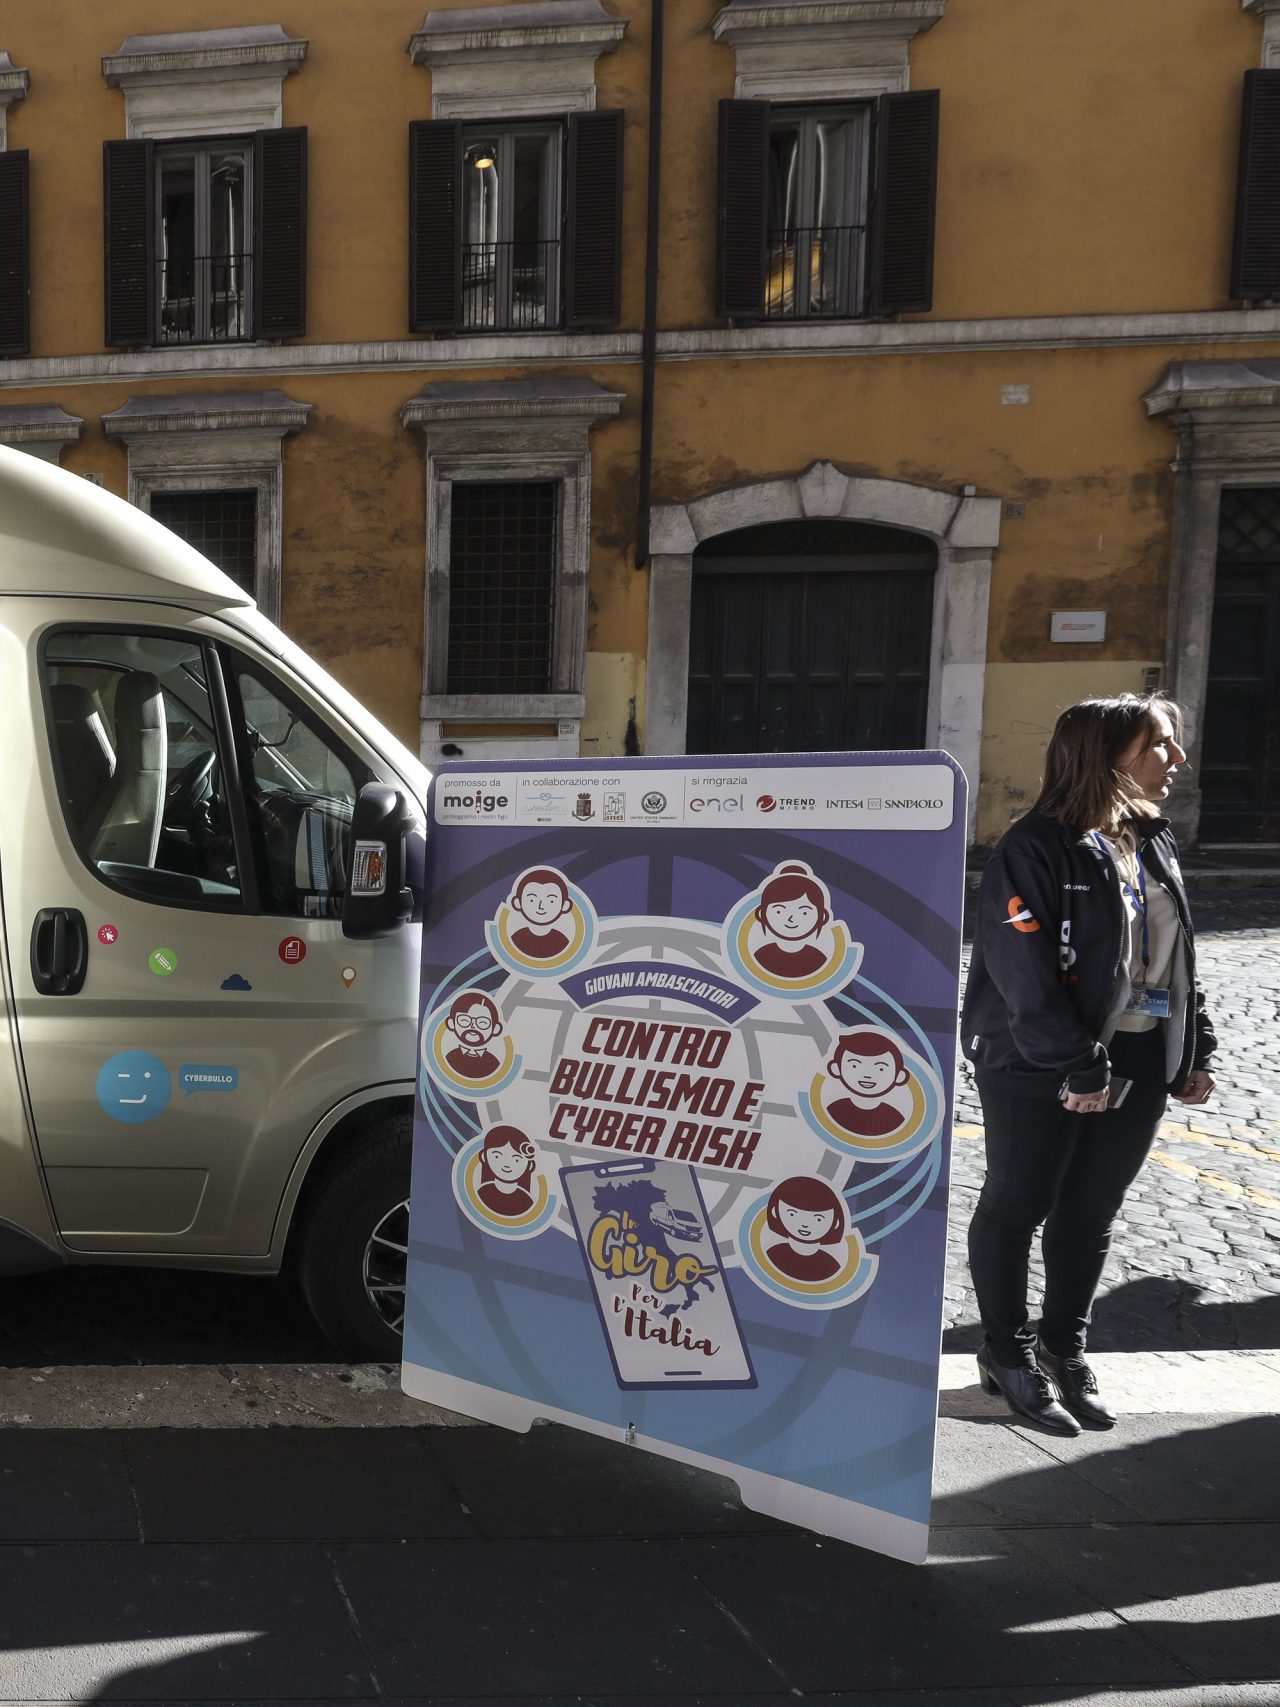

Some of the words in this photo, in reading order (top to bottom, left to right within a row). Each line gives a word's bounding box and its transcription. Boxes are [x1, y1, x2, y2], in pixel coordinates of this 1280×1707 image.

[444, 779, 487, 789] promosso
[489, 778, 501, 787] da
[522, 778, 530, 786] in
[532, 777, 599, 787] collaborazione
[603, 778, 621, 786] con
[691, 776, 700, 786] si
[703, 776, 748, 788] ringrazia
[443, 790, 509, 814] moige
[690, 794, 745, 812] enel
[780, 798, 815, 806] TREND
[826, 800, 864, 809] INTESA
[884, 799, 943, 809] SANPAOLO
[584, 970, 636, 996] GIOVANI
[636, 971, 741, 1010] AMBASCIATORI
[581, 1017, 732, 1070] CONTRO
[184, 1074, 233, 1083] CYBERBULLO
[549, 1058, 735, 1119] BULLISMO
[733, 1082, 766, 1123] E
[548, 1102, 669, 1156] CYBER
[668, 1121, 762, 1171] RISK
[621, 1210, 640, 1230] In
[590, 1214, 719, 1292] Giro
[631, 1283, 662, 1309] Per
